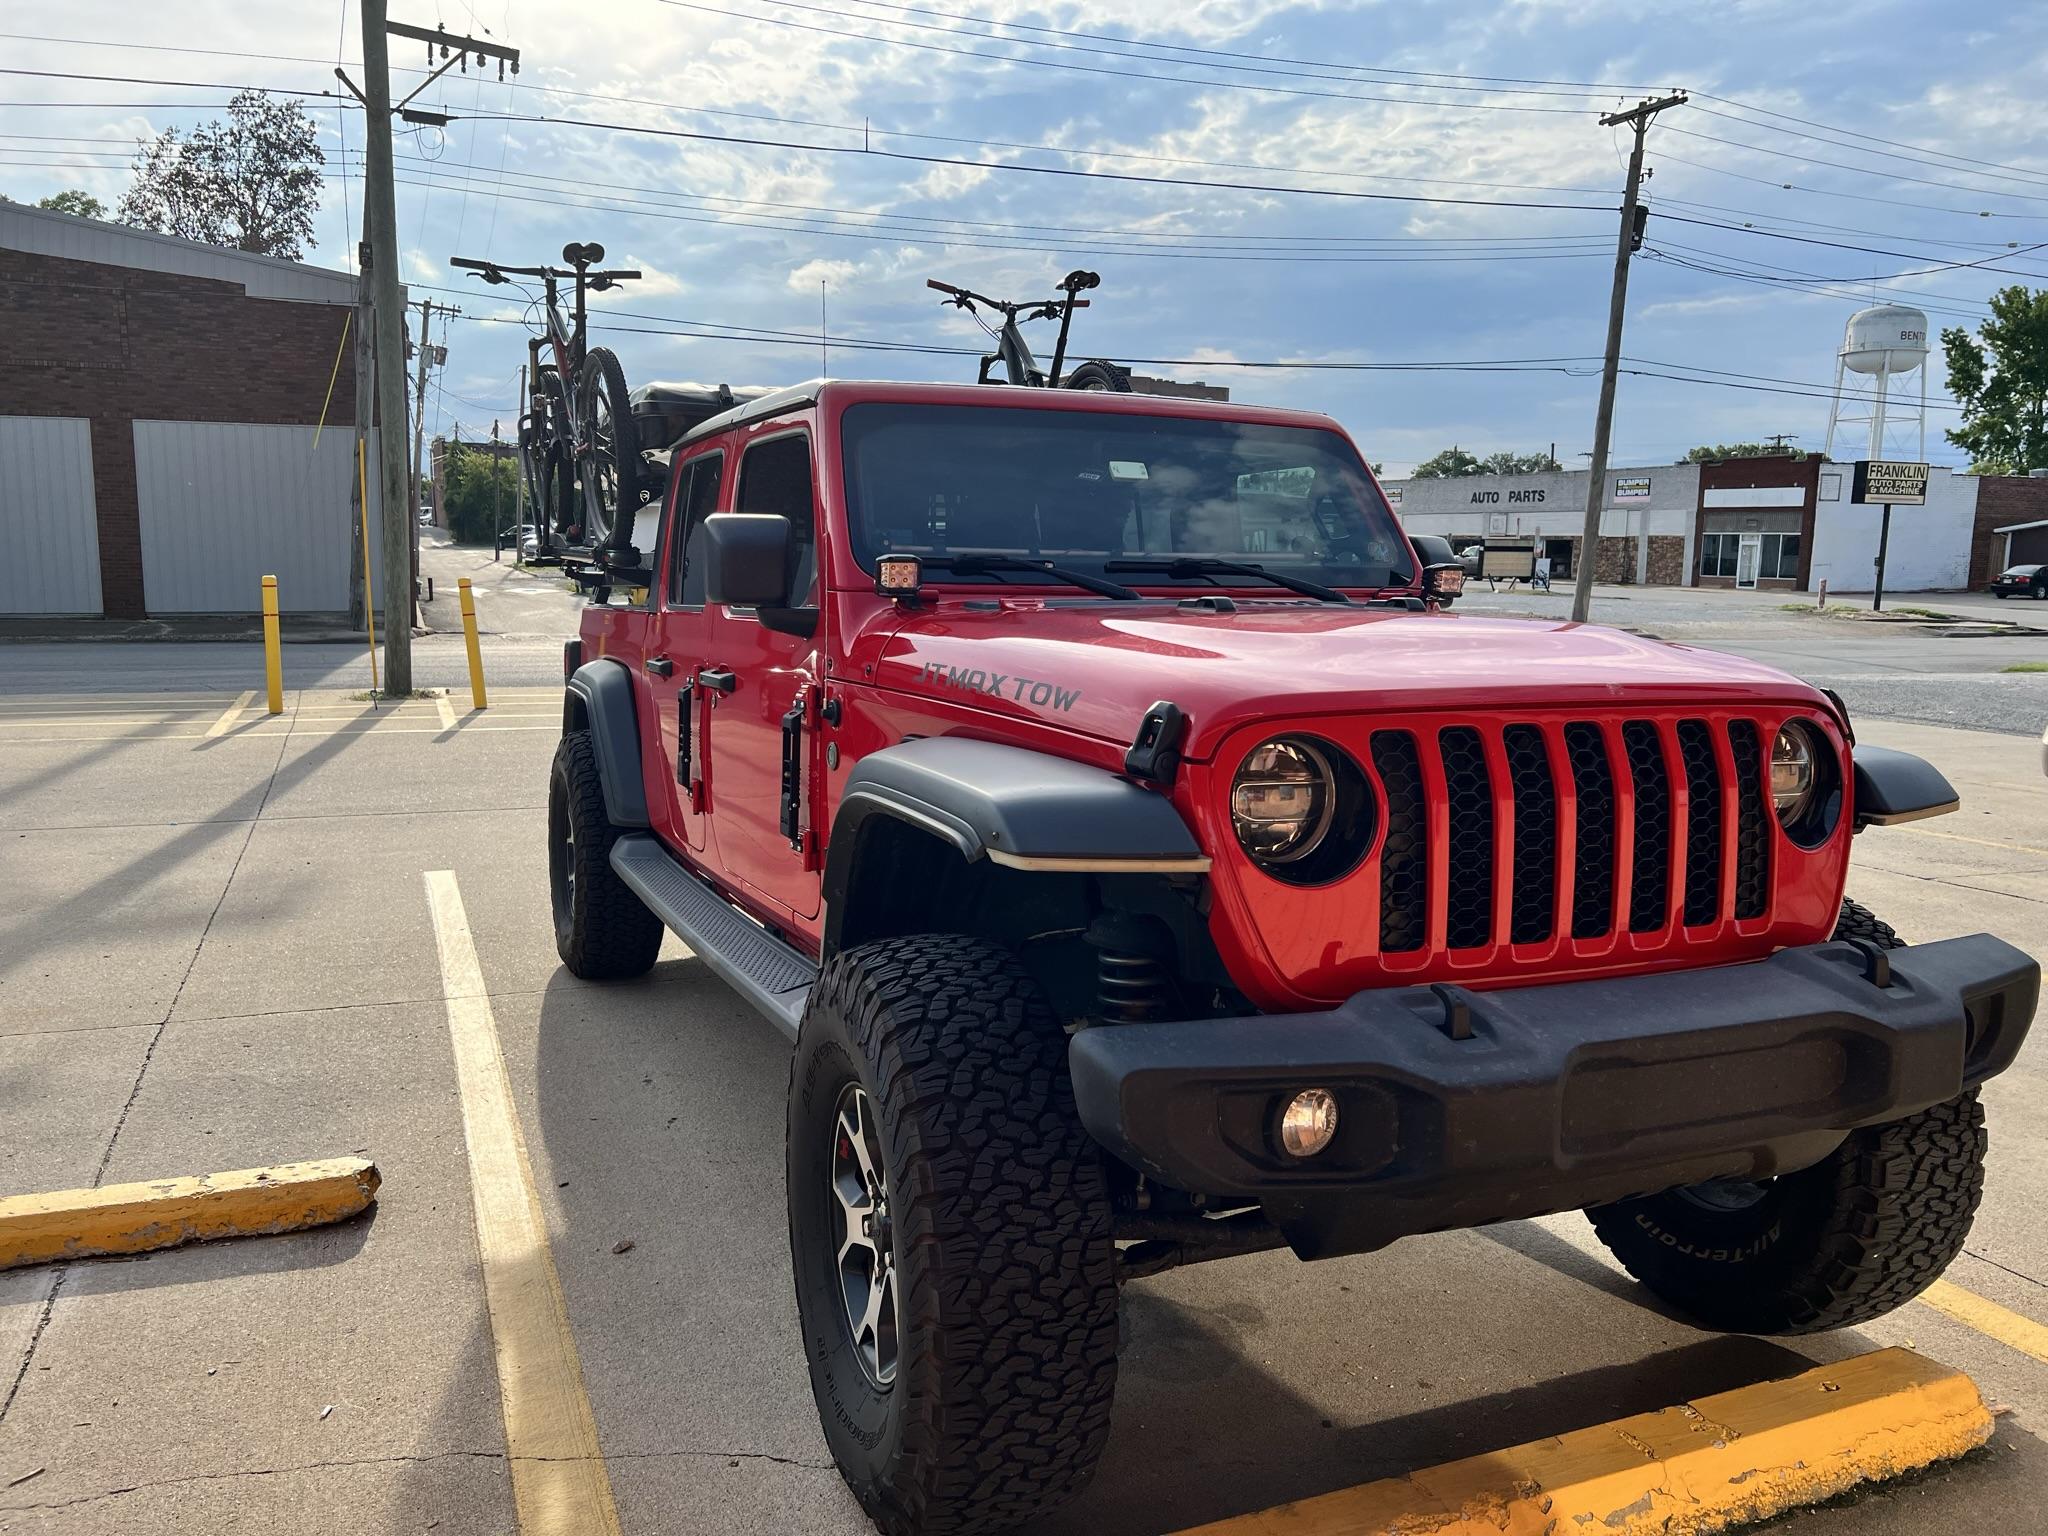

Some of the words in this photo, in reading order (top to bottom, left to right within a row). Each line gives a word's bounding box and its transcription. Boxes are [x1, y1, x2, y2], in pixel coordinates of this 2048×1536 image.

[1869, 465, 1926, 479] FRANKLIN
[1870, 486, 1877, 494] &
[1879, 487, 1920, 495] MACHINE
[1895, 480, 1923, 488] PARTS
[1470, 491, 1500, 504] AUTO
[1508, 490, 1545, 503] PARTS
[1013, 677, 1082, 712] TOW
